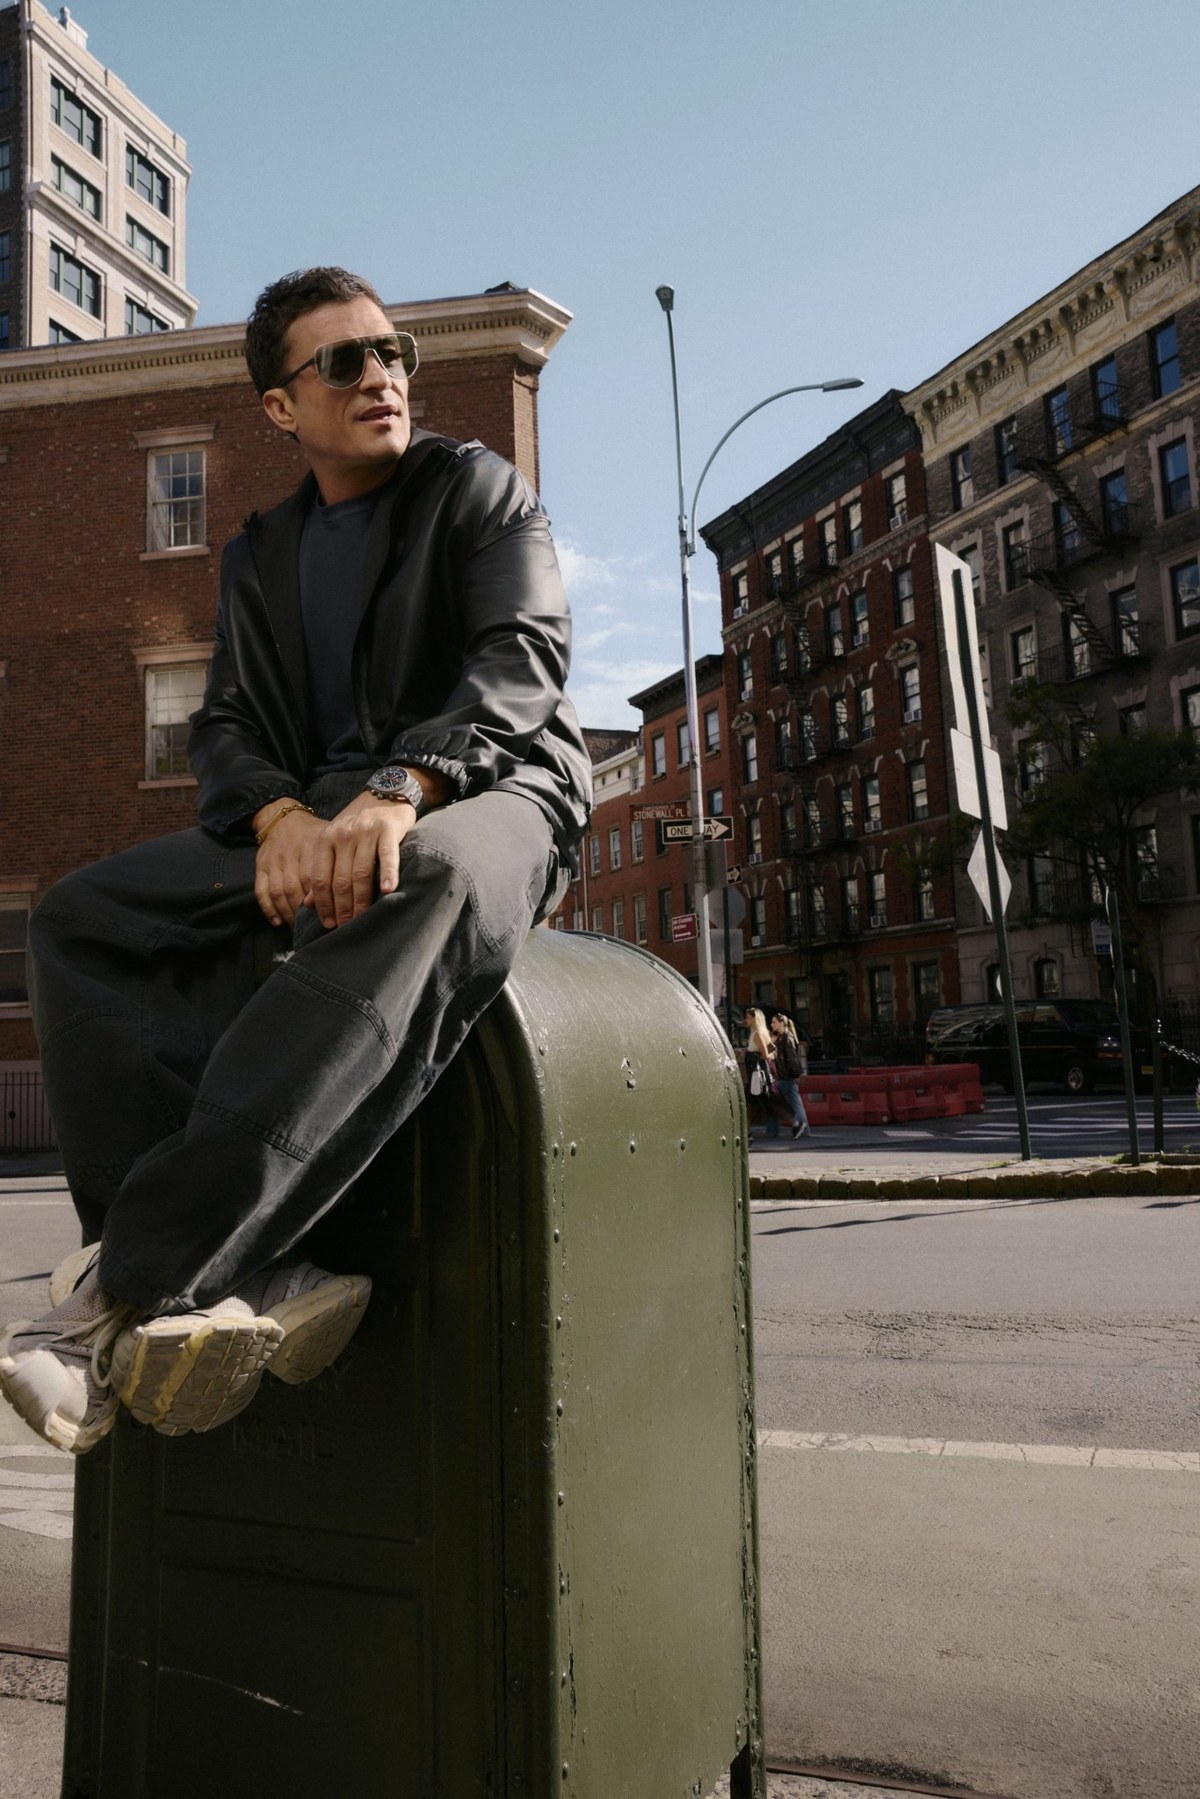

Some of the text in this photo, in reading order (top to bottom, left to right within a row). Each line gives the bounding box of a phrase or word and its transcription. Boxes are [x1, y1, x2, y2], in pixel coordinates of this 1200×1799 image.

[634, 808, 685, 820] STONEWALL PL
[670, 825, 718, 836] ONE AY
